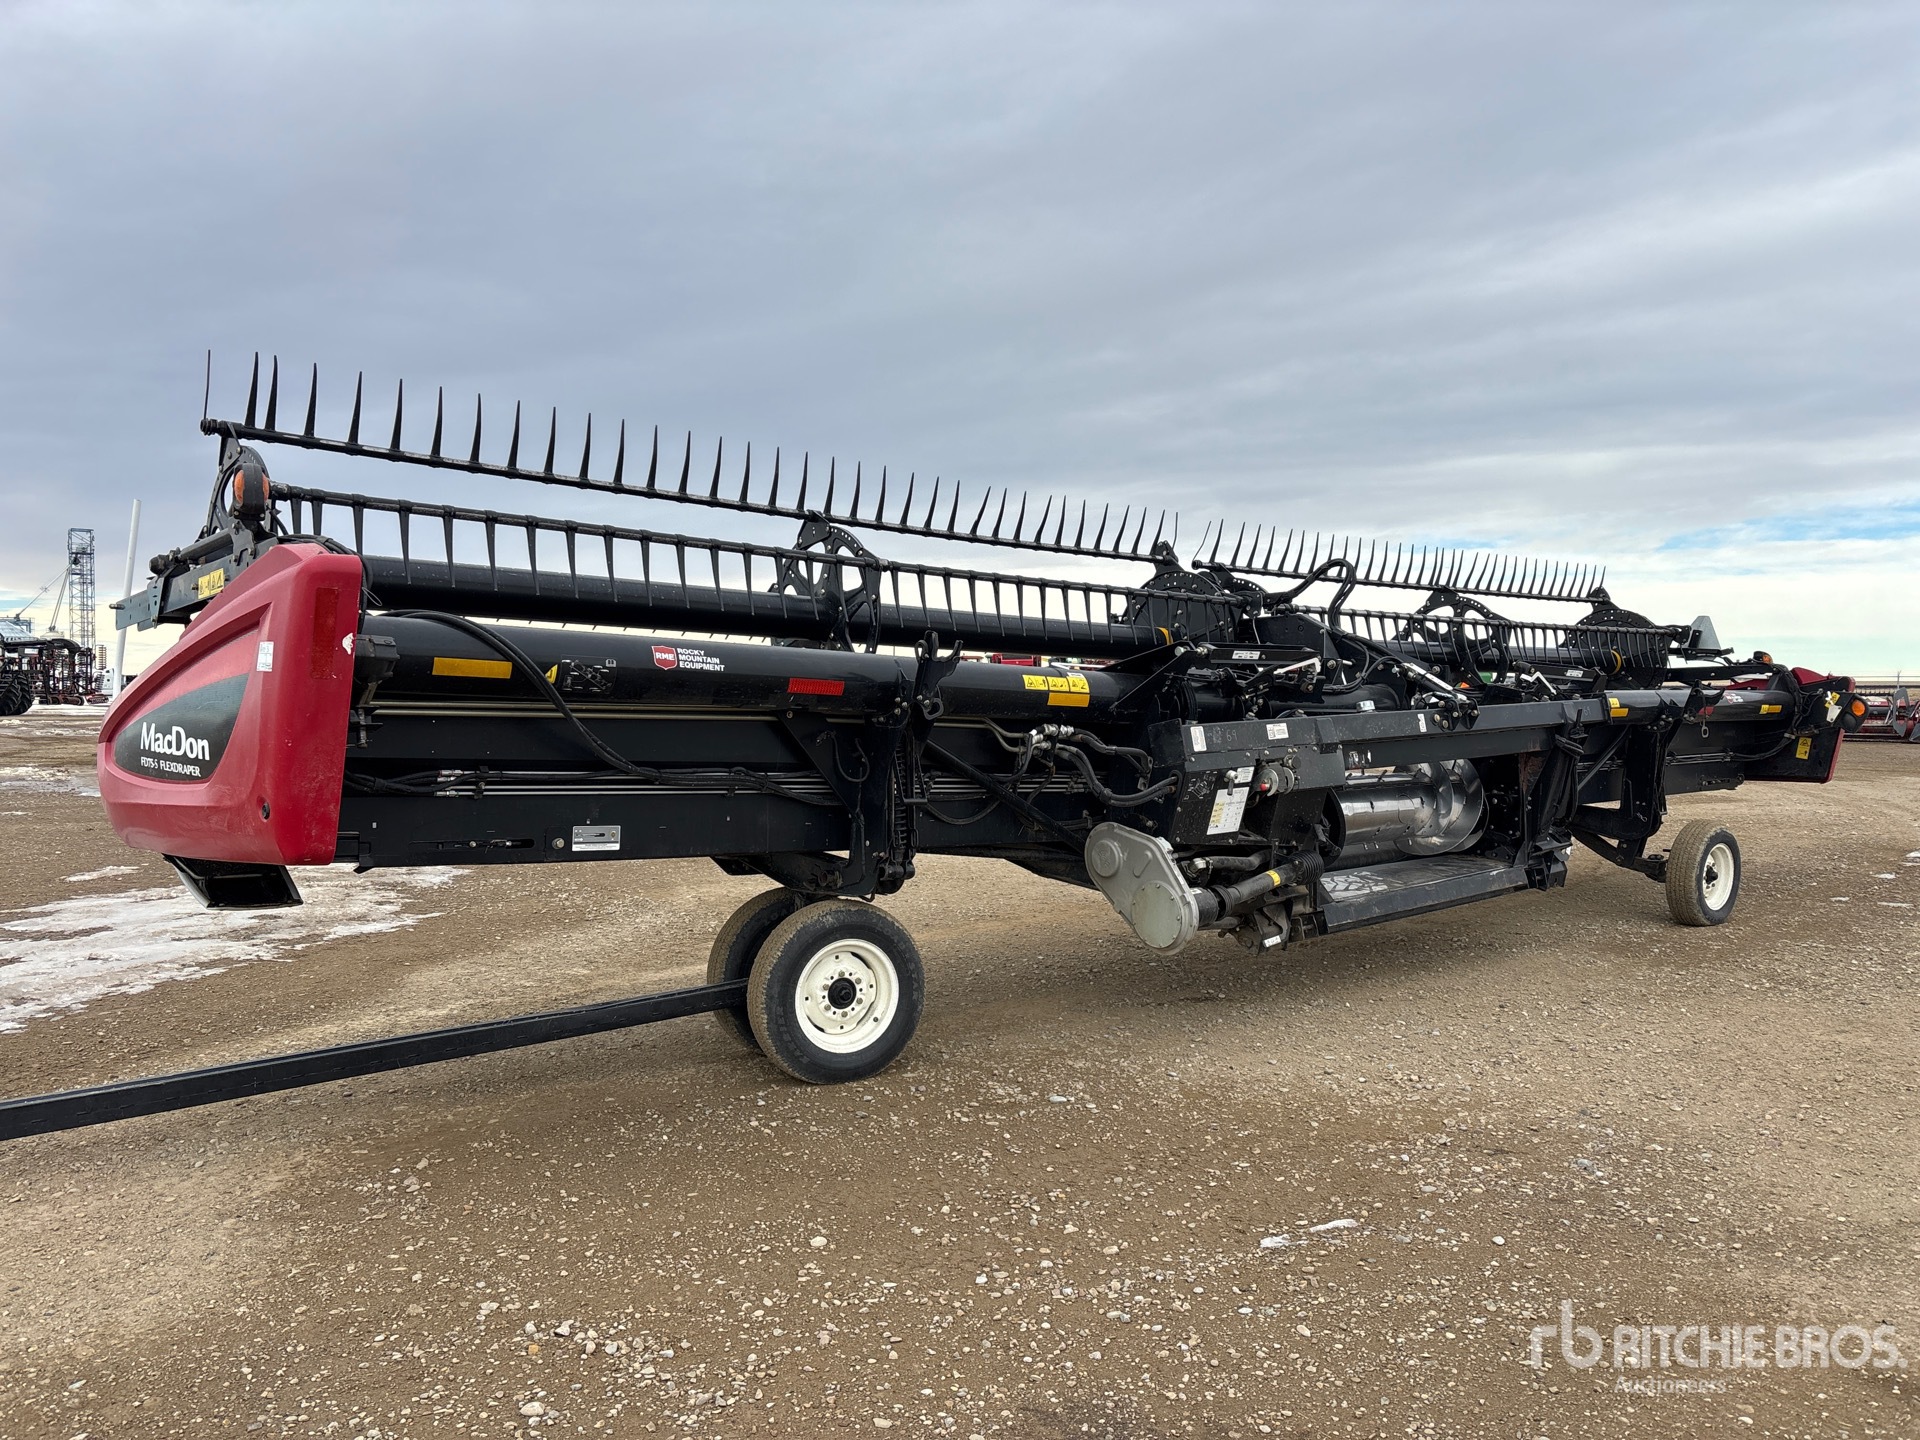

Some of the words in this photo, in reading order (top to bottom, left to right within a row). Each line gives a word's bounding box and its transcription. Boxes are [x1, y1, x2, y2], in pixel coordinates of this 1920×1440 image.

[655, 652, 675, 660] RME
[677, 648, 704, 656] ROCKY
[678, 654, 720, 664] MOUNTAIN
[679, 661, 725, 671] EQUIPMENT
[140, 721, 210, 761] MacDon
[160, 759, 201, 777] FLEXDRAPER
